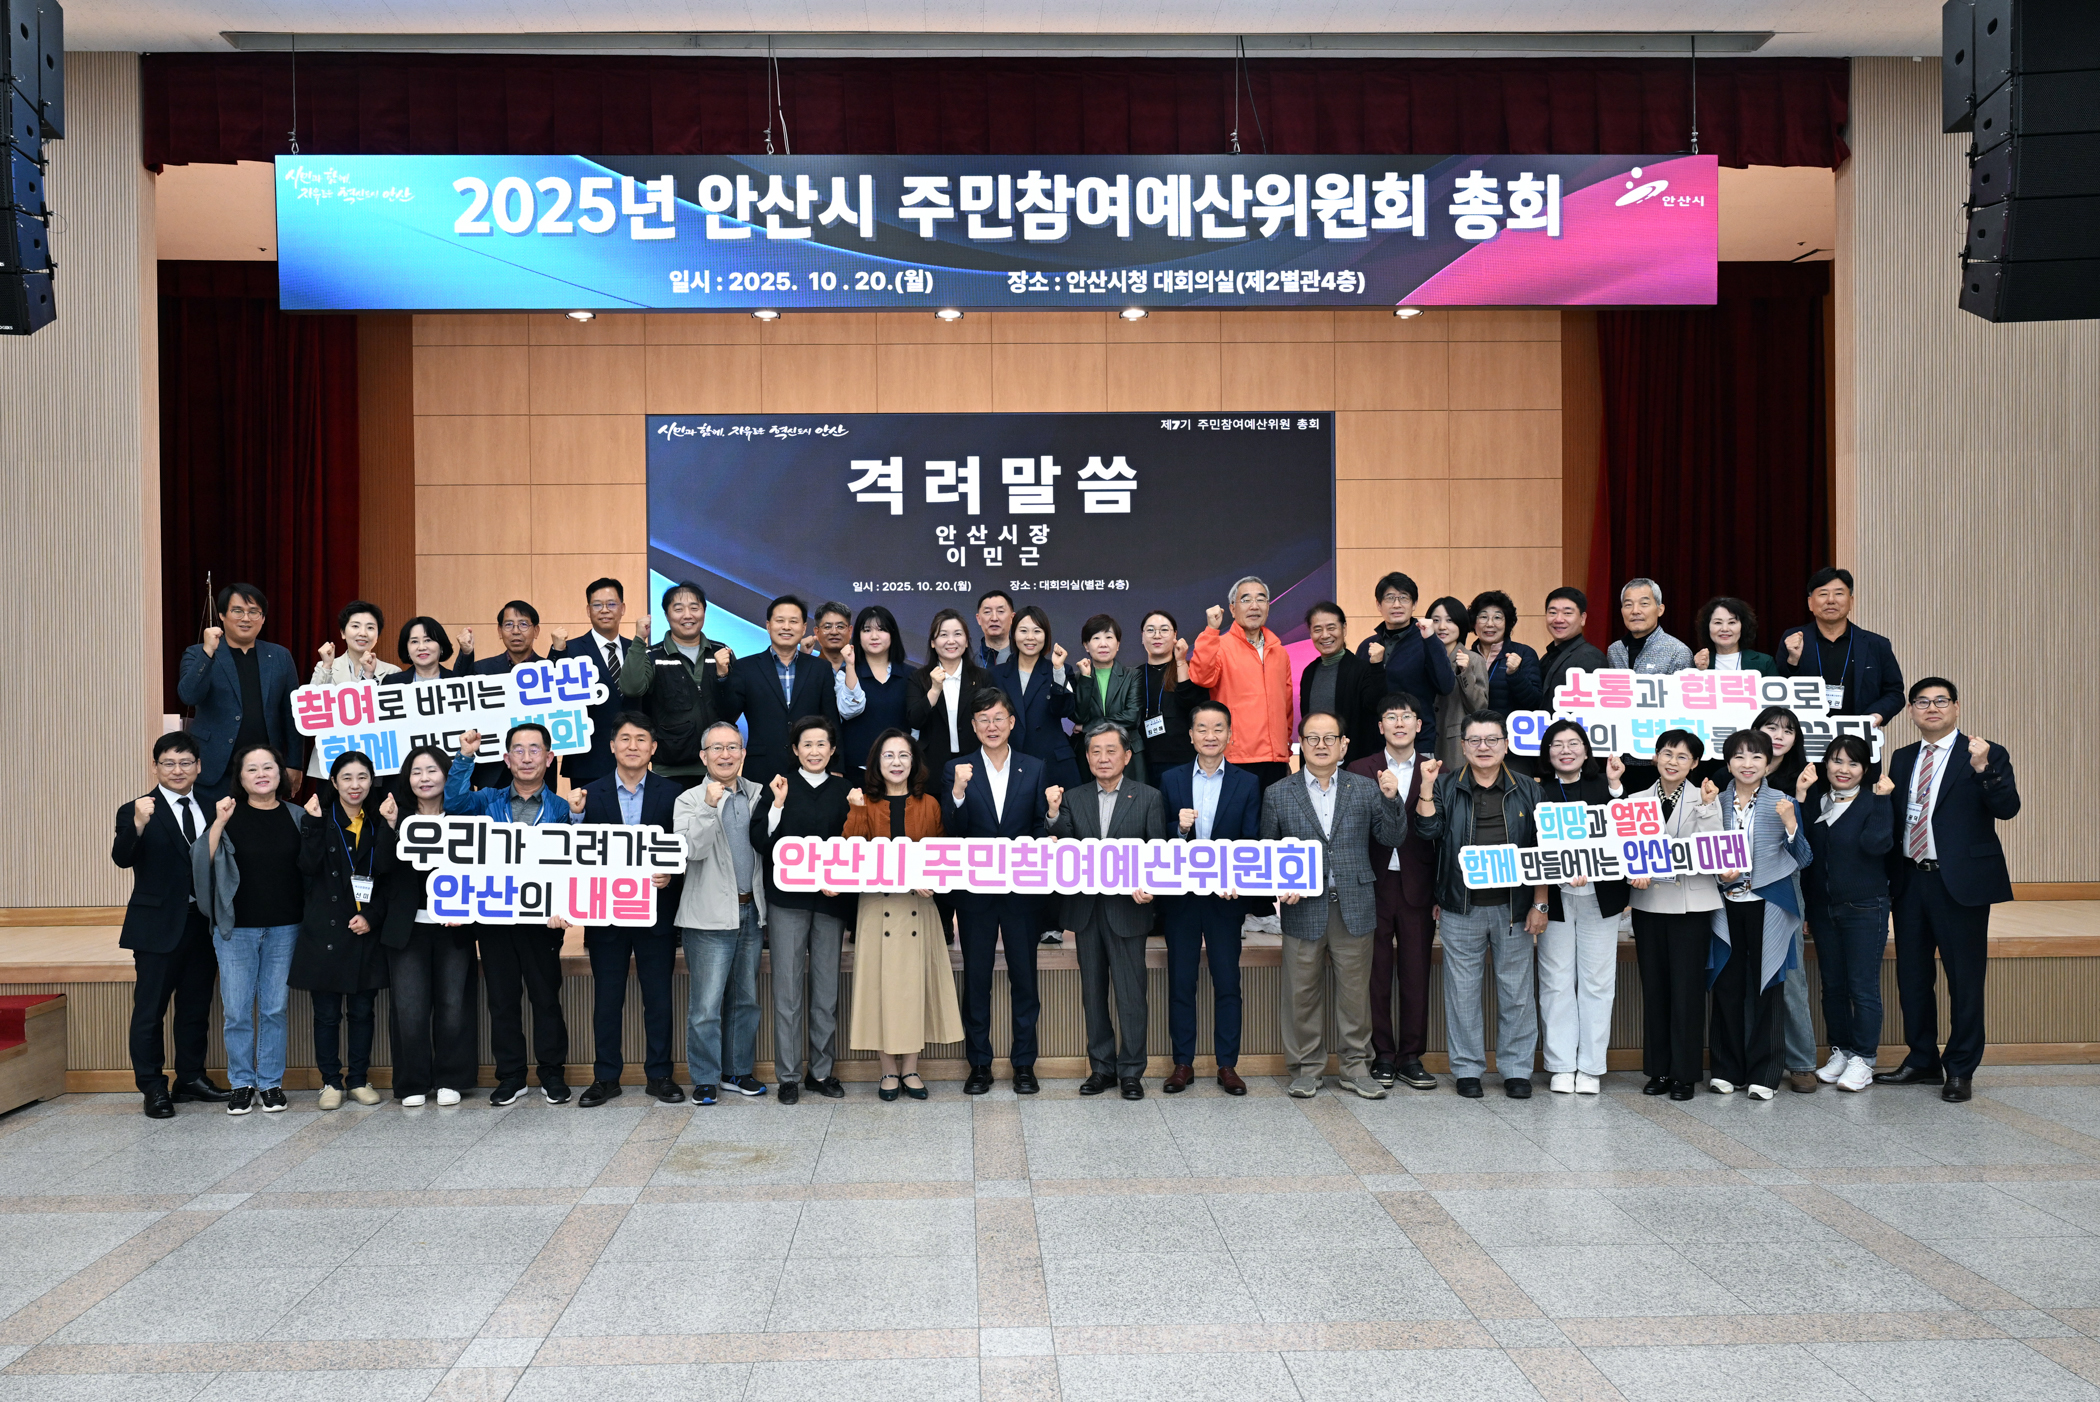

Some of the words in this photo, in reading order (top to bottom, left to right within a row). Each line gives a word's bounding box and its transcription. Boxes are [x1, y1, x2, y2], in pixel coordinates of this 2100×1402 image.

[382, 186, 415, 202] 안산
[453, 175, 676, 240] 2025년
[698, 174, 873, 240] 안산시
[898, 171, 1425, 240] 주민참여예산위원회
[1449, 171, 1560, 240] 총회
[1662, 195, 1704, 207] 안산시
[669, 269, 710, 294] 일시
[728, 271, 798, 291] 2025.
[1008, 270, 1050, 294] 장소
[1066, 269, 1147, 293] 안산시청
[1153, 269, 1366, 295] 대회의실(제2별관4층)
[657, 421, 697, 441] 시민과
[815, 424, 849, 437] 안산
[1160, 418, 1191, 431] 제7기
[1197, 418, 1291, 431] 주민참여예산위원
[1296, 418, 1320, 431] 총회
[852, 581, 873, 592] 일시
[882, 581, 914, 592] 2025.
[916, 581, 933, 592] 10.
[935, 580, 972, 592] 20.(월)
[1009, 580, 1031, 591] 장소
[1039, 579, 1105, 591] 대회의실(별관
[1107, 579, 1130, 591] 4층)
[297, 684, 406, 730] 참여로
[415, 680, 505, 716] 바뀌는
[516, 661, 603, 706] 안산,
[1559, 672, 1668, 709] 소통과
[1679, 674, 1824, 710] 협력으로
[1512, 716, 1617, 752] 안의
[1538, 805, 1608, 840] 희망과
[1611, 801, 1661, 837] 열정
[403, 822, 526, 865] 우리가
[538, 829, 682, 867] 그려가는
[1463, 848, 1518, 884] 함께
[1520, 846, 1620, 881] 만들어가는
[1623, 838, 1694, 875] 안산의
[1696, 834, 1748, 870] 미래
[779, 843, 906, 886] 안산시
[922, 843, 1317, 890] 주민참여예산위원회
[433, 874, 552, 918] 안산의
[568, 877, 651, 920] 내일
